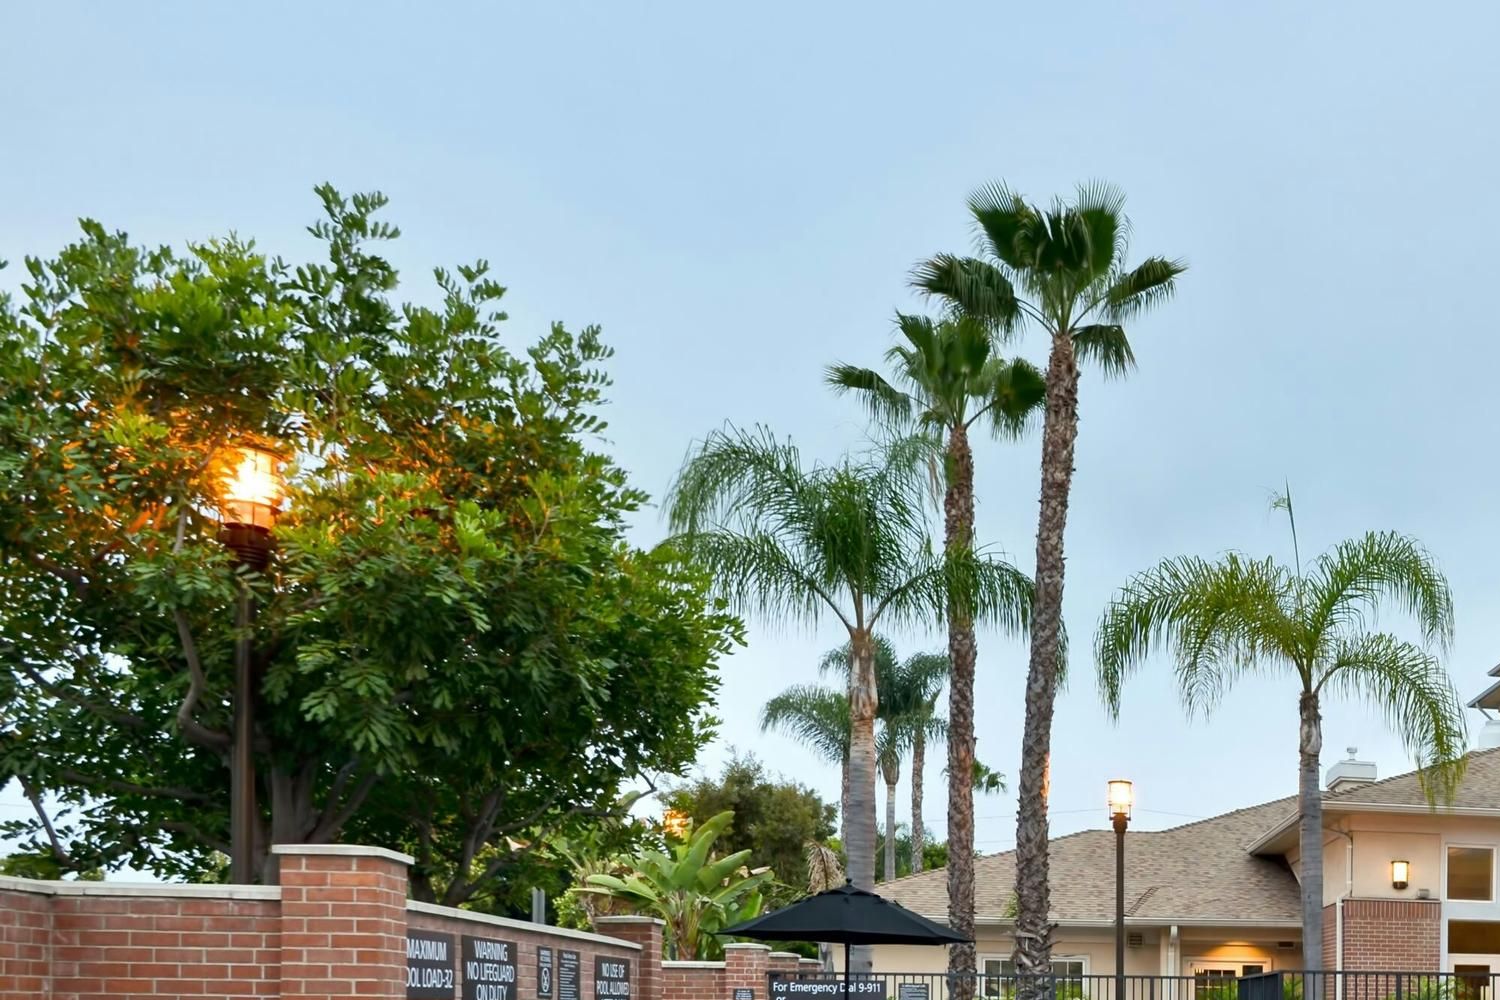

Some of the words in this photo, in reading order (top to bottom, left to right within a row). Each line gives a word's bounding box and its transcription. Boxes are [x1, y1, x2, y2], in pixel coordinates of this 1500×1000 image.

[407, 938, 447, 961] MAXIMUM
[474, 940, 508, 961] WARNING
[422, 967, 453, 989] LOAD-32
[467, 961, 480, 980] NO
[480, 962, 515, 982] LIFEGUARD
[601, 963, 610, 977] NO
[610, 963, 618, 978] USE
[618, 964, 625, 978] OF
[596, 980, 609, 996] POOL
[609, 981, 630, 996] ALLOWED
[773, 982, 788, 992] For
[790, 982, 838, 994] Emergency
[839, 982, 856, 992] Dal
[858, 983, 881, 992] 9-911
